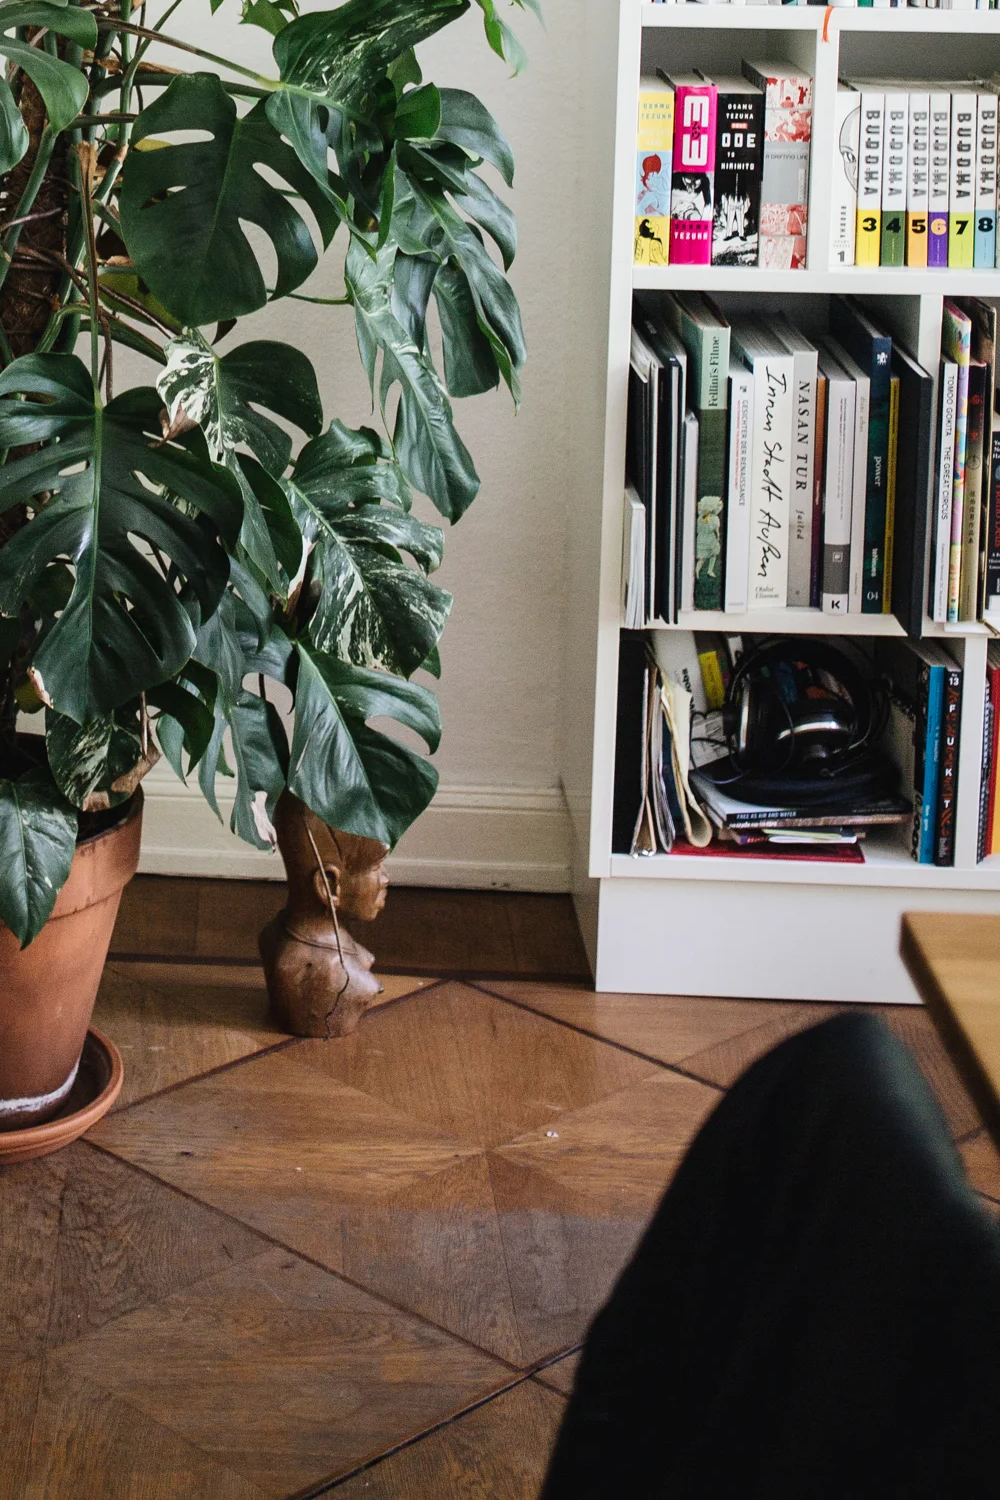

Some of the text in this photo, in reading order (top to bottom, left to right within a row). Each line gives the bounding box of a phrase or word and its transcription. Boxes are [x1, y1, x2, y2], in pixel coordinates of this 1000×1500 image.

[722, 133, 756, 148] ODE
[864, 110, 880, 196] BUDDHA
[888, 111, 904, 197] BUDDHA
[912, 112, 927, 198] BUDDHA
[932, 111, 948, 198] BUDDHA
[956, 112, 972, 199] BUDDHA
[980, 110, 995, 196] BUDDHA
[674, 232, 708, 240] TEZUKA
[863, 218, 877, 232] 3
[886, 218, 901, 233] 4
[912, 220, 926, 233] 5
[930, 218, 946, 236] 6
[956, 221, 969, 235] 7
[978, 217, 993, 232] 8
[837, 251, 845, 262] 1
[708, 336, 720, 407] Fellini's Filme
[740, 400, 748, 439] GESICHTER
[945, 376, 955, 437] TOMOO GOKITA
[756, 366, 787, 578] Innen Stadt Außen
[795, 380, 810, 540] NASAN TUR failed
[873, 456, 883, 487] power
[738, 457, 746, 507] RENAISSANCE
[941, 446, 951, 520] THE GREAT CIRCUS
[870, 548, 879, 577] teNeues
[831, 600, 840, 609] K
[867, 591, 878, 600] 04
[950, 677, 959, 686] 13
